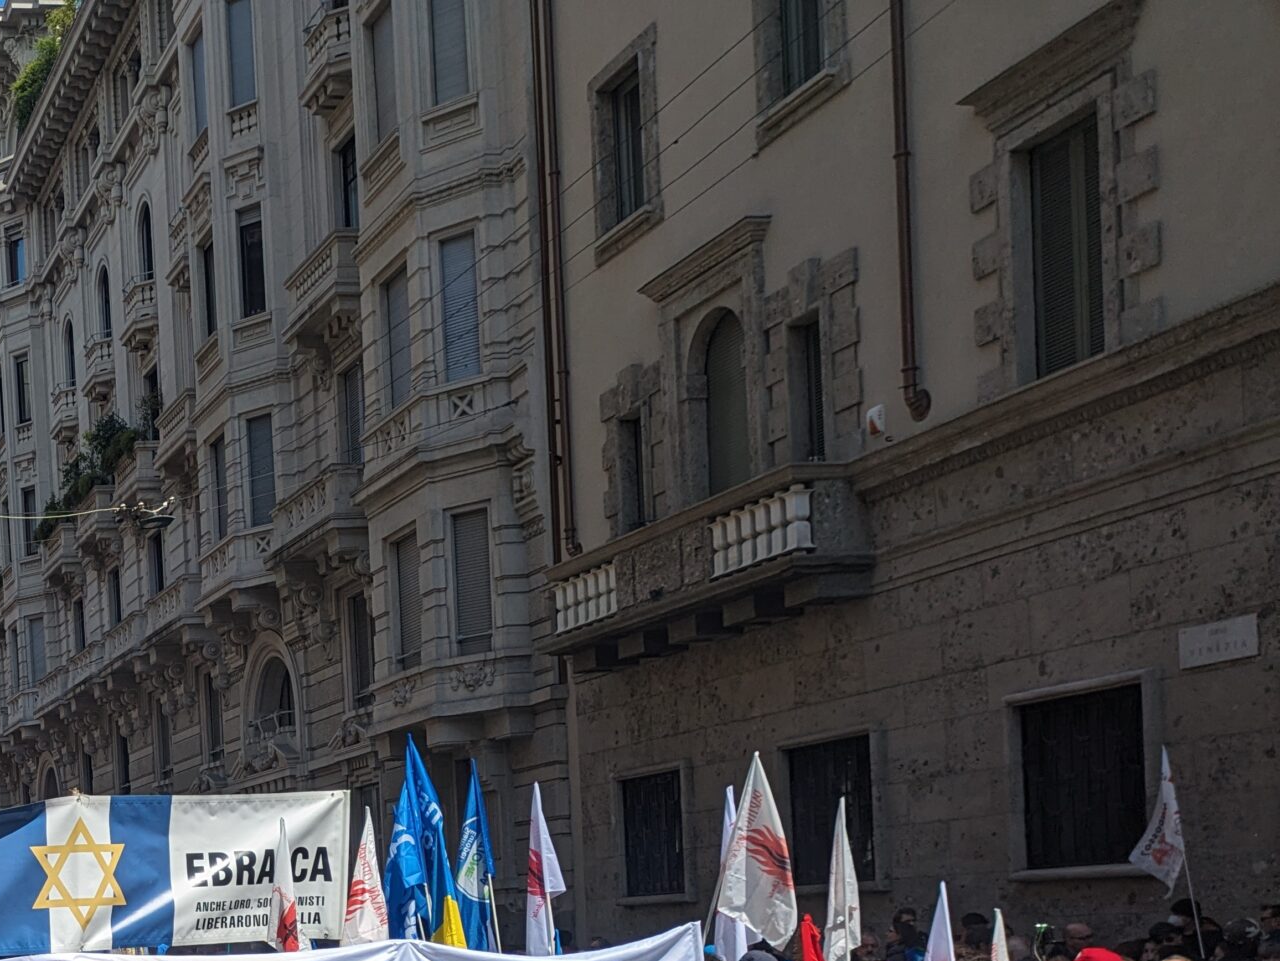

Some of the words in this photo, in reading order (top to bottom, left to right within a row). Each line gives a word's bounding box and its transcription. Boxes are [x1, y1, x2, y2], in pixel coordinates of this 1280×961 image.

[186, 846, 333, 888] EBRACA
[195, 898, 227, 913] ANCHE
[229, 897, 254, 912] LORO,
[298, 895, 325, 908] NISTI
[195, 914, 269, 931] LIBERARONO
[300, 911, 322, 925] LIA
